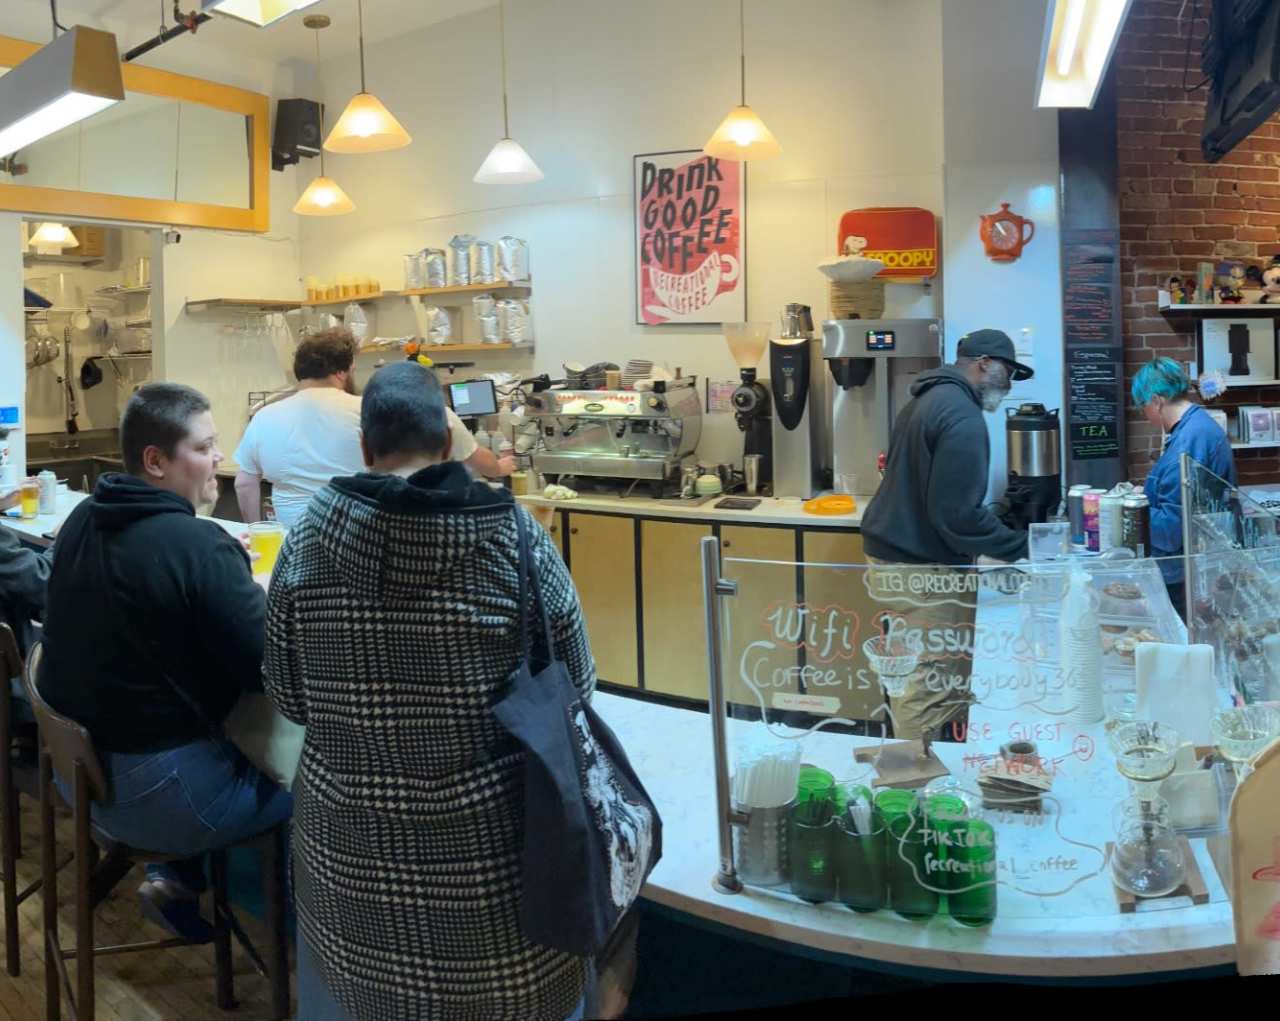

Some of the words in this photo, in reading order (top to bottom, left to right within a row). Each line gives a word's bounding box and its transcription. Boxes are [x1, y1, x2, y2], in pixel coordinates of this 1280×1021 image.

[644, 186, 720, 230] GOOD
[641, 209, 733, 273] COFFEE
[669, 288, 708, 314] COFFEE
[1080, 425, 1108, 437] TEA
[875, 573, 905, 593] IG
[769, 608, 851, 656] Wifi
[753, 657, 842, 690] Coffee
[847, 664, 870, 689] is
[952, 721, 993, 741] USE
[1008, 721, 1067, 741] GUEST
